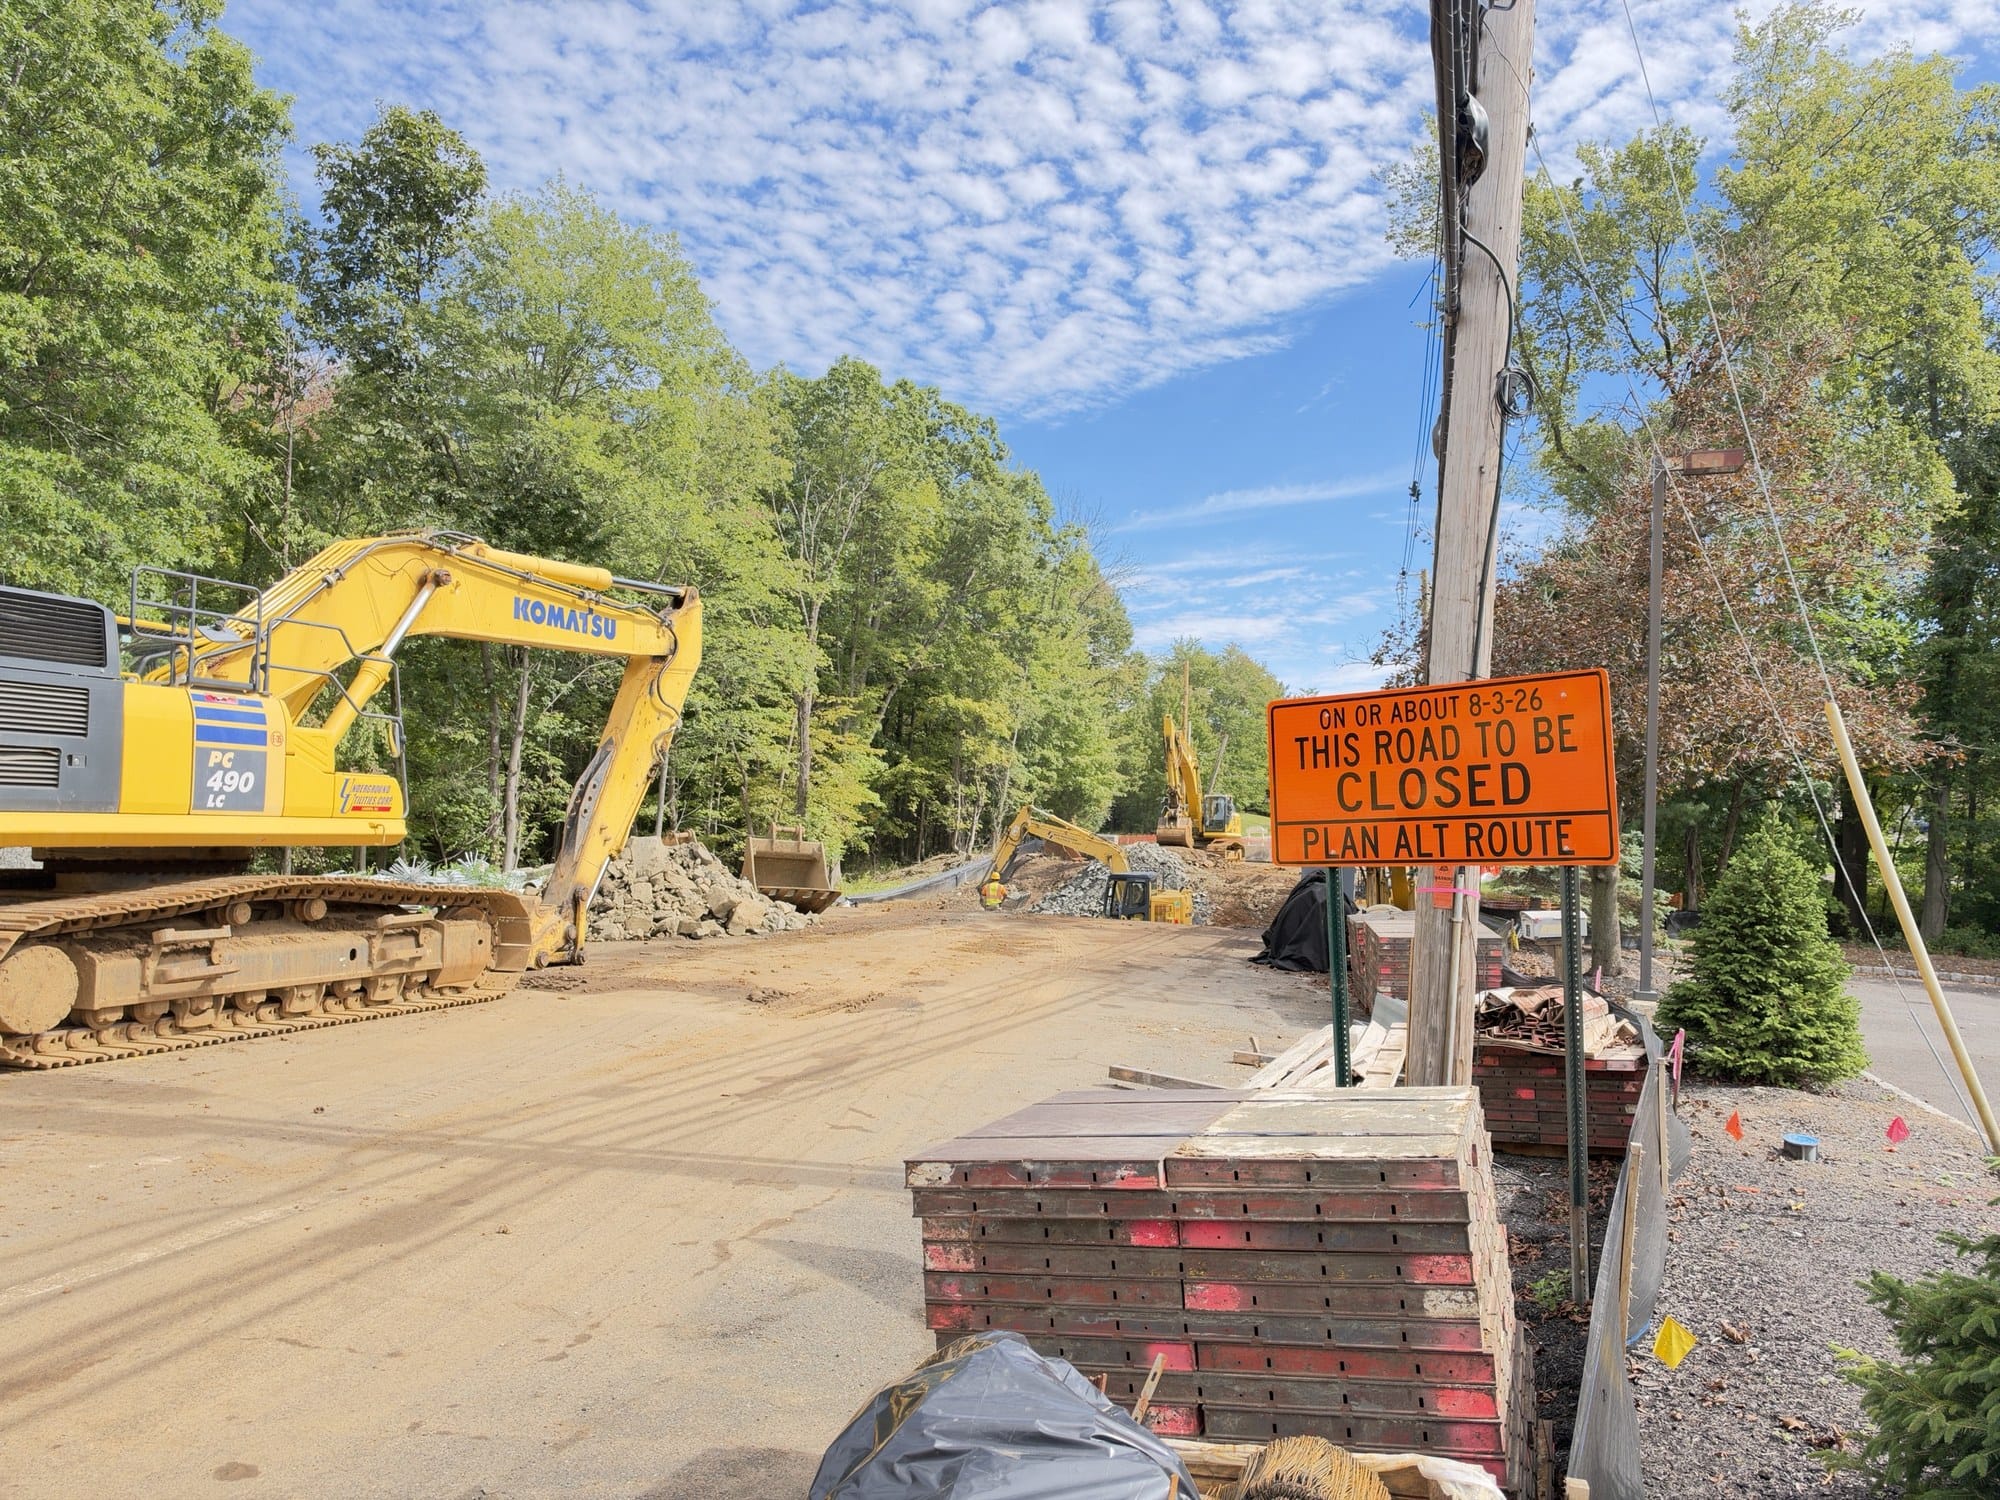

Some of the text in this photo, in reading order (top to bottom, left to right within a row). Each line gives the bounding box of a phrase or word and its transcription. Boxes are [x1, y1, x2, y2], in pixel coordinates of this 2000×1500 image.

[514, 596, 616, 640] KOMATSU
[1319, 688, 1543, 731] ON OR ABOUT 8-3-26
[208, 750, 235, 769] PC
[1295, 713, 1579, 770] THIS ROAD TO BE
[206, 769, 255, 793] 490
[206, 793, 226, 808] LC
[1337, 762, 1531, 813] CLOSED
[1303, 819, 1576, 860] PLAN ALT ROUTE
